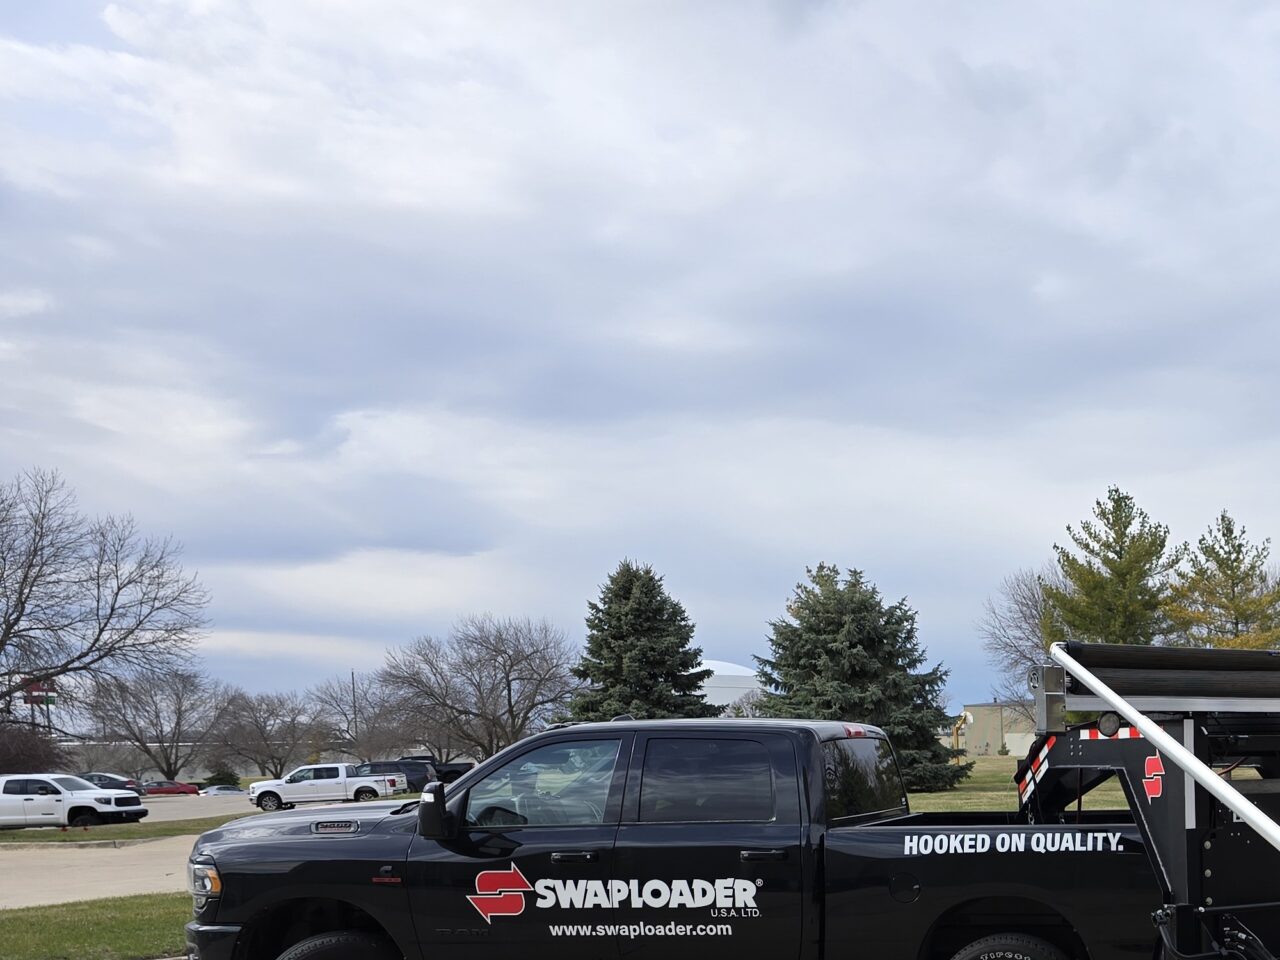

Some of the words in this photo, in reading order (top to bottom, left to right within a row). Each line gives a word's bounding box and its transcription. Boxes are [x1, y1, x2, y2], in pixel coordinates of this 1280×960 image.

[904, 834, 991, 855] HOOKED
[996, 833, 1026, 853] ON
[1031, 832, 1124, 853] QUALITY.
[710, 909, 739, 917] U.S.A.
[741, 909, 762, 917] LTD.
[549, 921, 733, 939] www.swaploader.com
